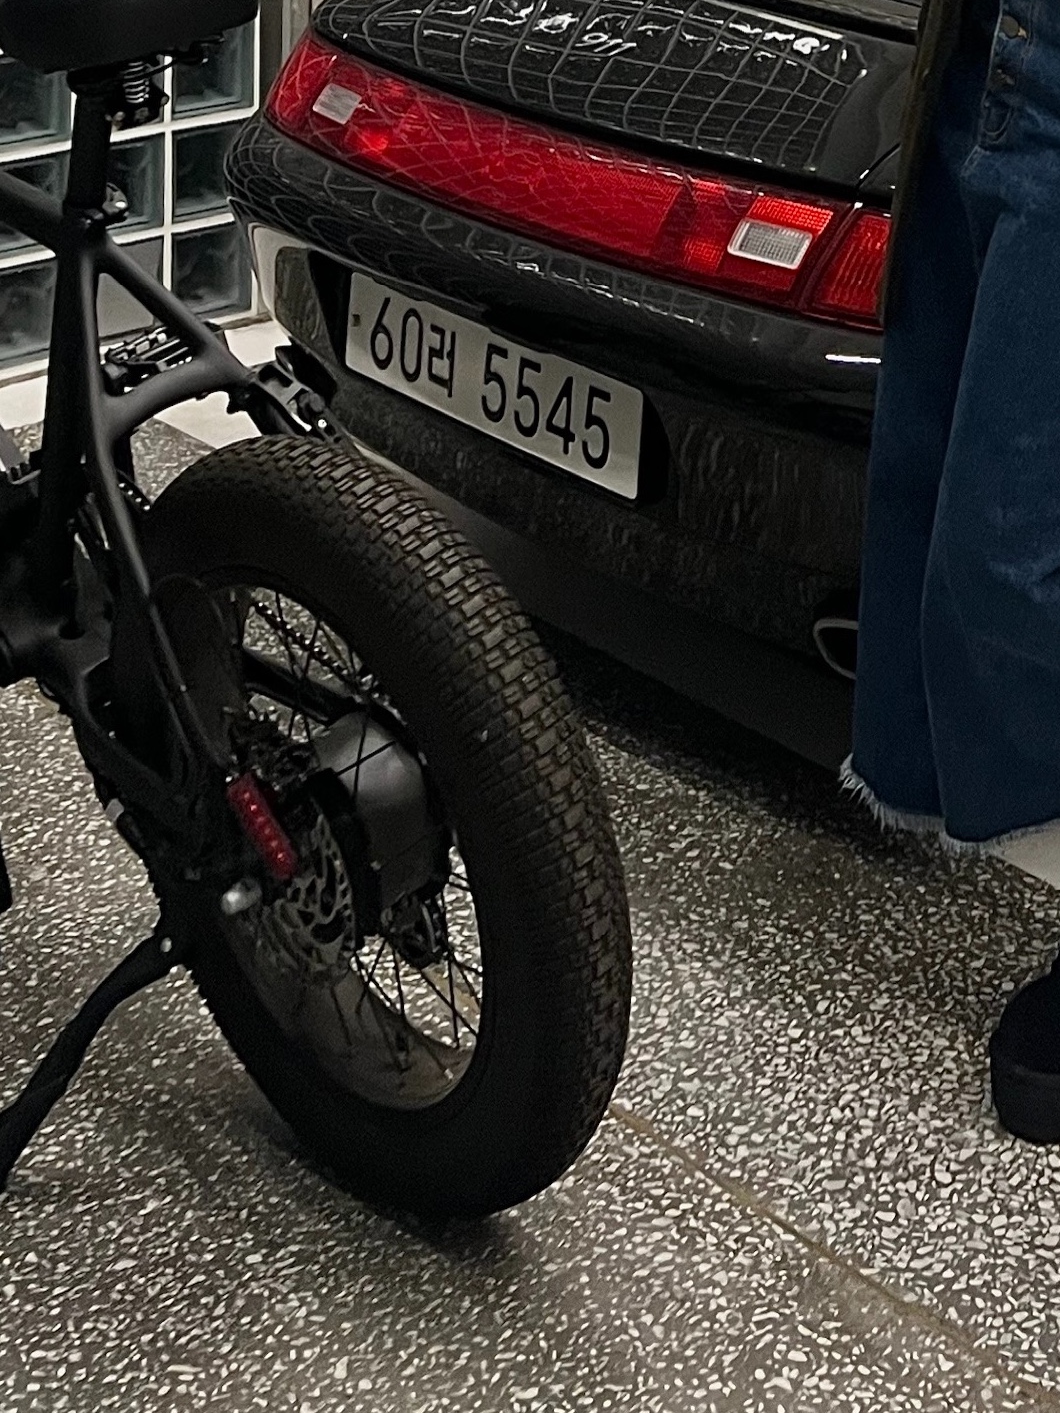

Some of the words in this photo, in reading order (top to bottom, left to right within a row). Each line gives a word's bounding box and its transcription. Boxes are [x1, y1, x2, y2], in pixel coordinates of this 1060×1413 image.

[574, 32, 637, 57] 911
[370, 297, 456, 398] 60러
[481, 343, 611, 470] 5545
